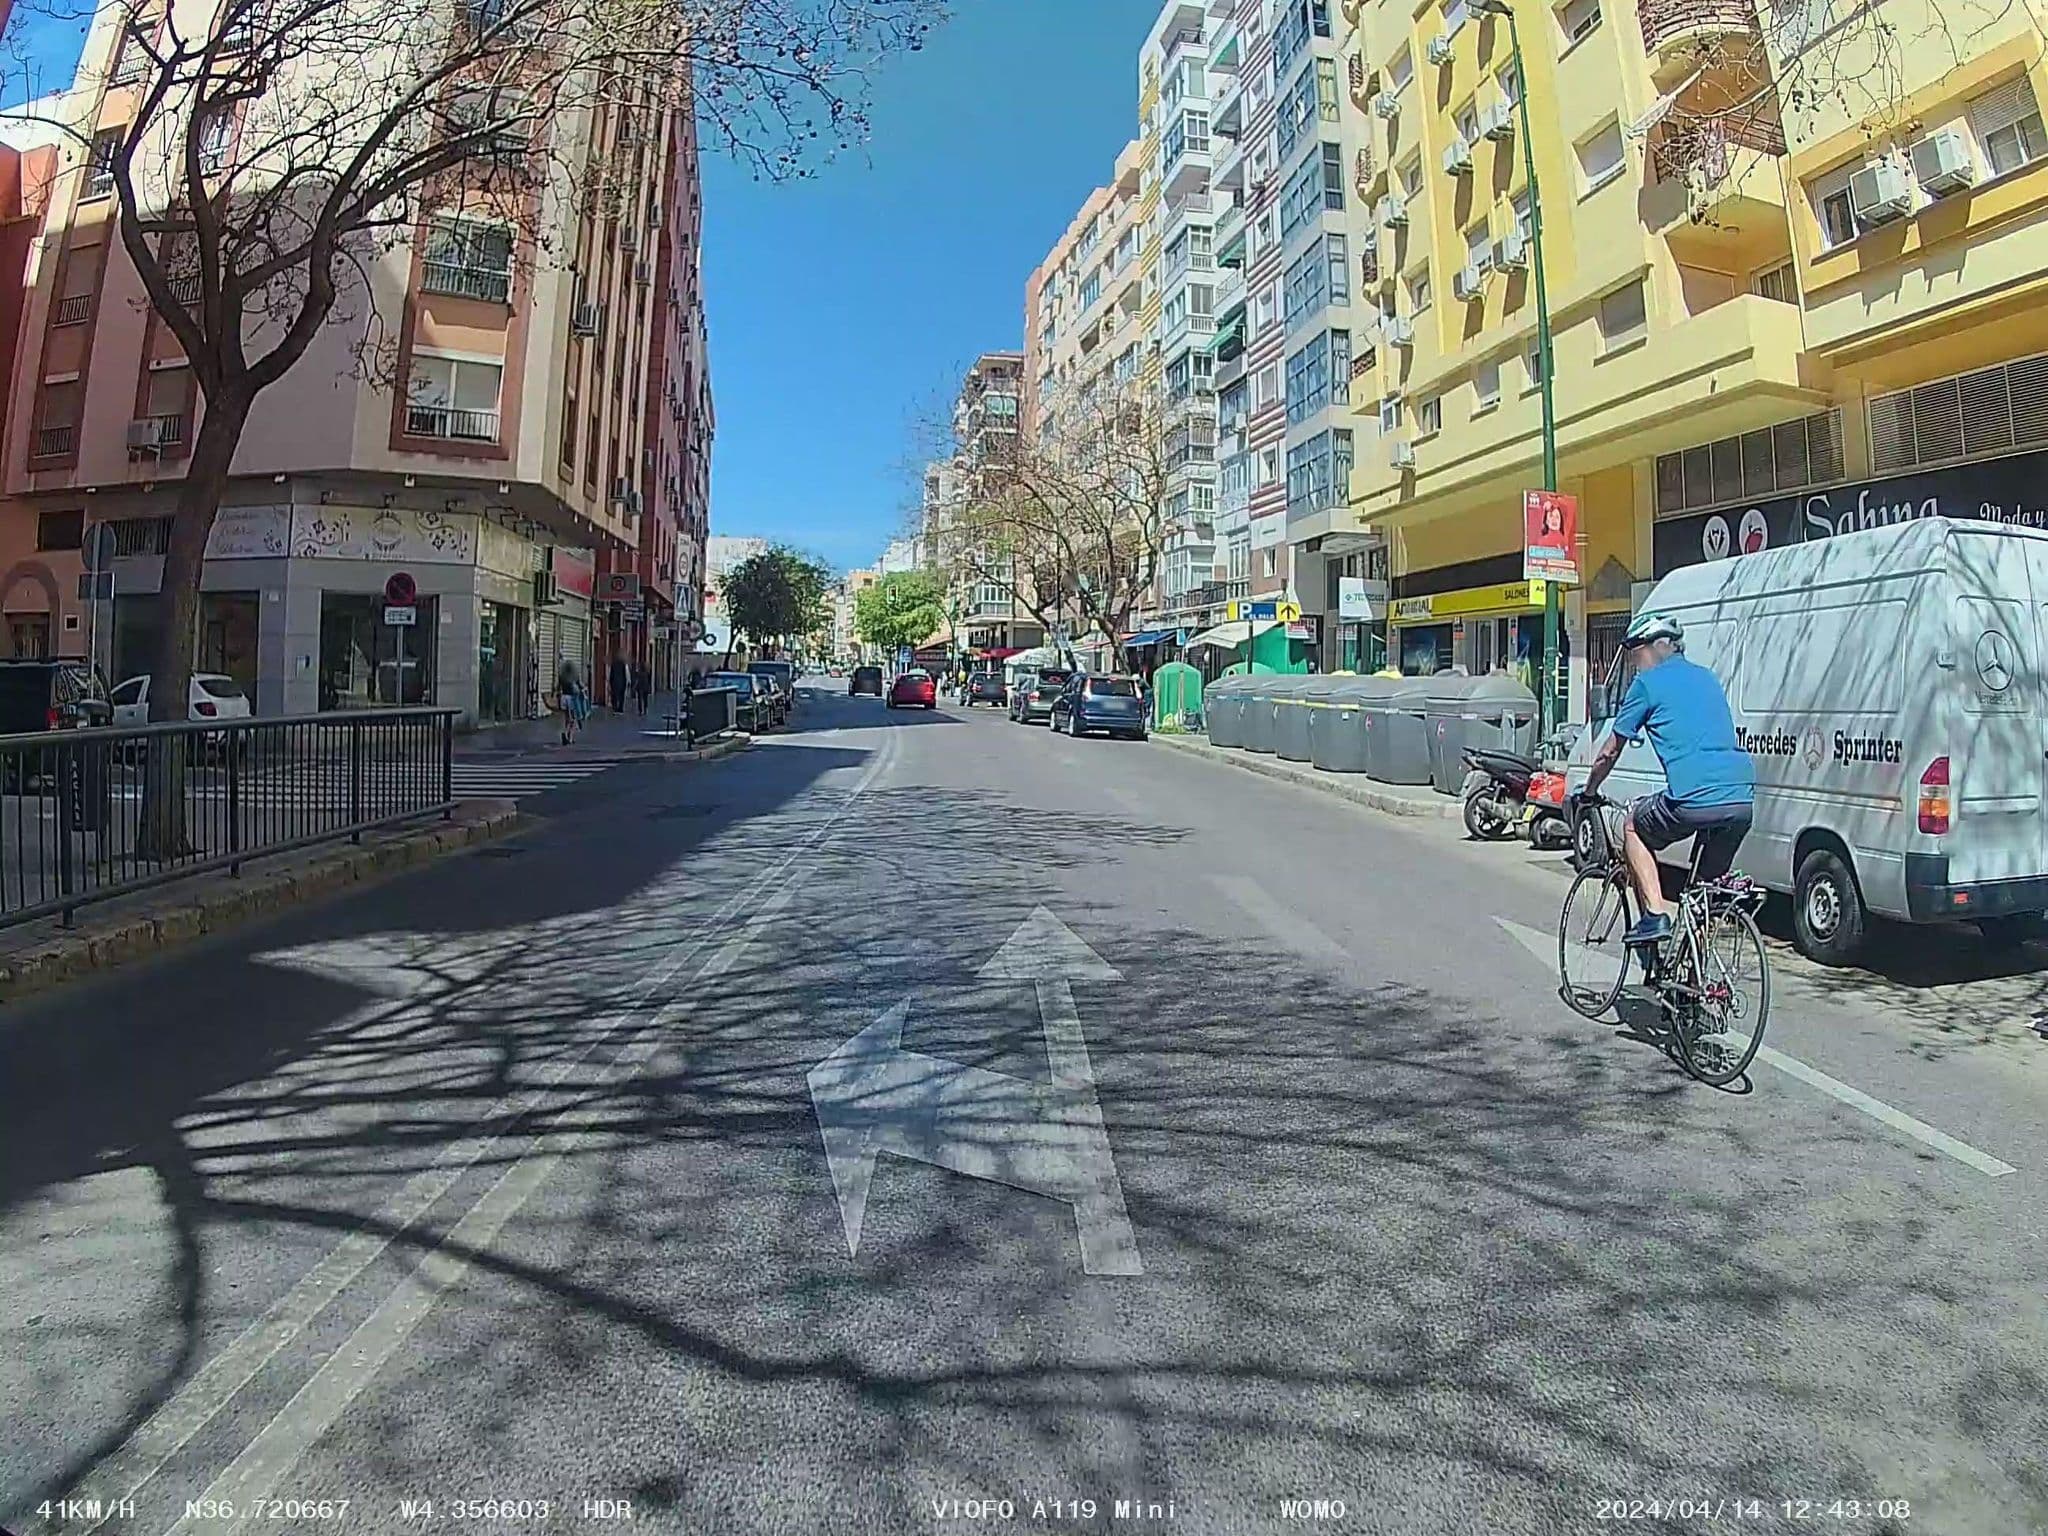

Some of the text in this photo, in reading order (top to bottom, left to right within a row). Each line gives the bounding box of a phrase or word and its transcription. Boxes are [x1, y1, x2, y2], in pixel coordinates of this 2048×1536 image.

[1980, 502, 2045, 528] Moda y
[1240, 603, 1252, 619] P
[1736, 727, 1797, 756] Mercedes
[1833, 729, 1903, 765] Sprinter
